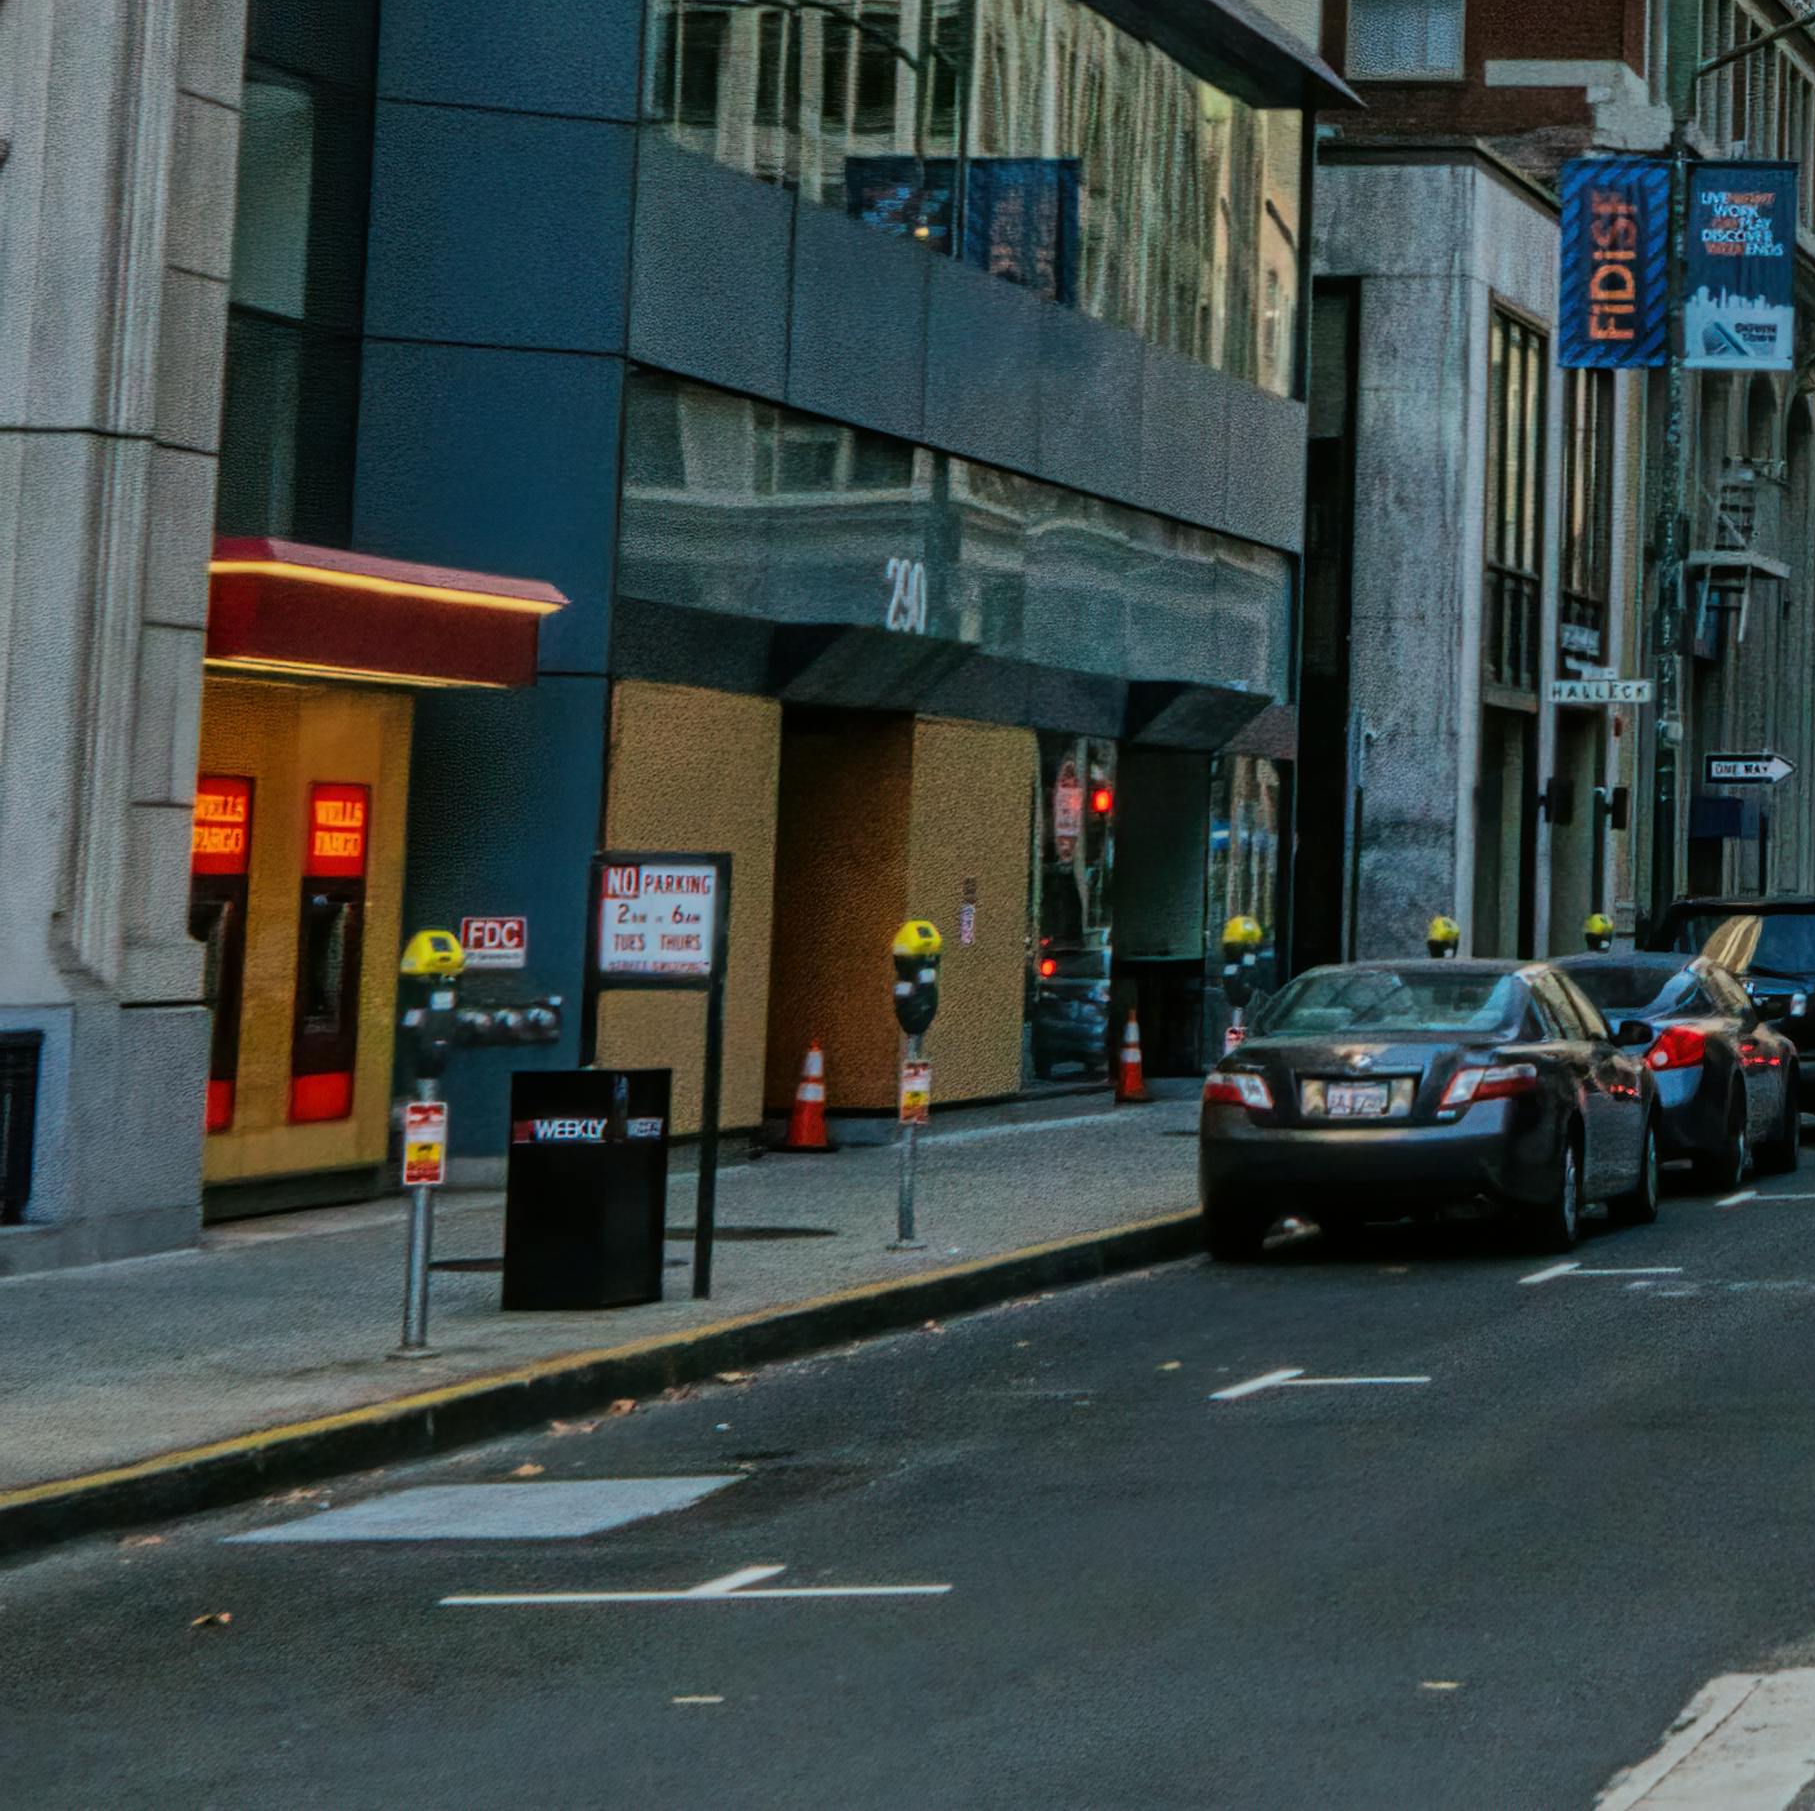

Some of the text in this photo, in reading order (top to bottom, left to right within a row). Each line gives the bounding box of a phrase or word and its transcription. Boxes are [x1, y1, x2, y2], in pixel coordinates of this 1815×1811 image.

[1552, 683, 1647, 700] HALLECK
[608, 867, 713, 895] NO PARKING
[534, 1117, 608, 1139] WEEKLY
